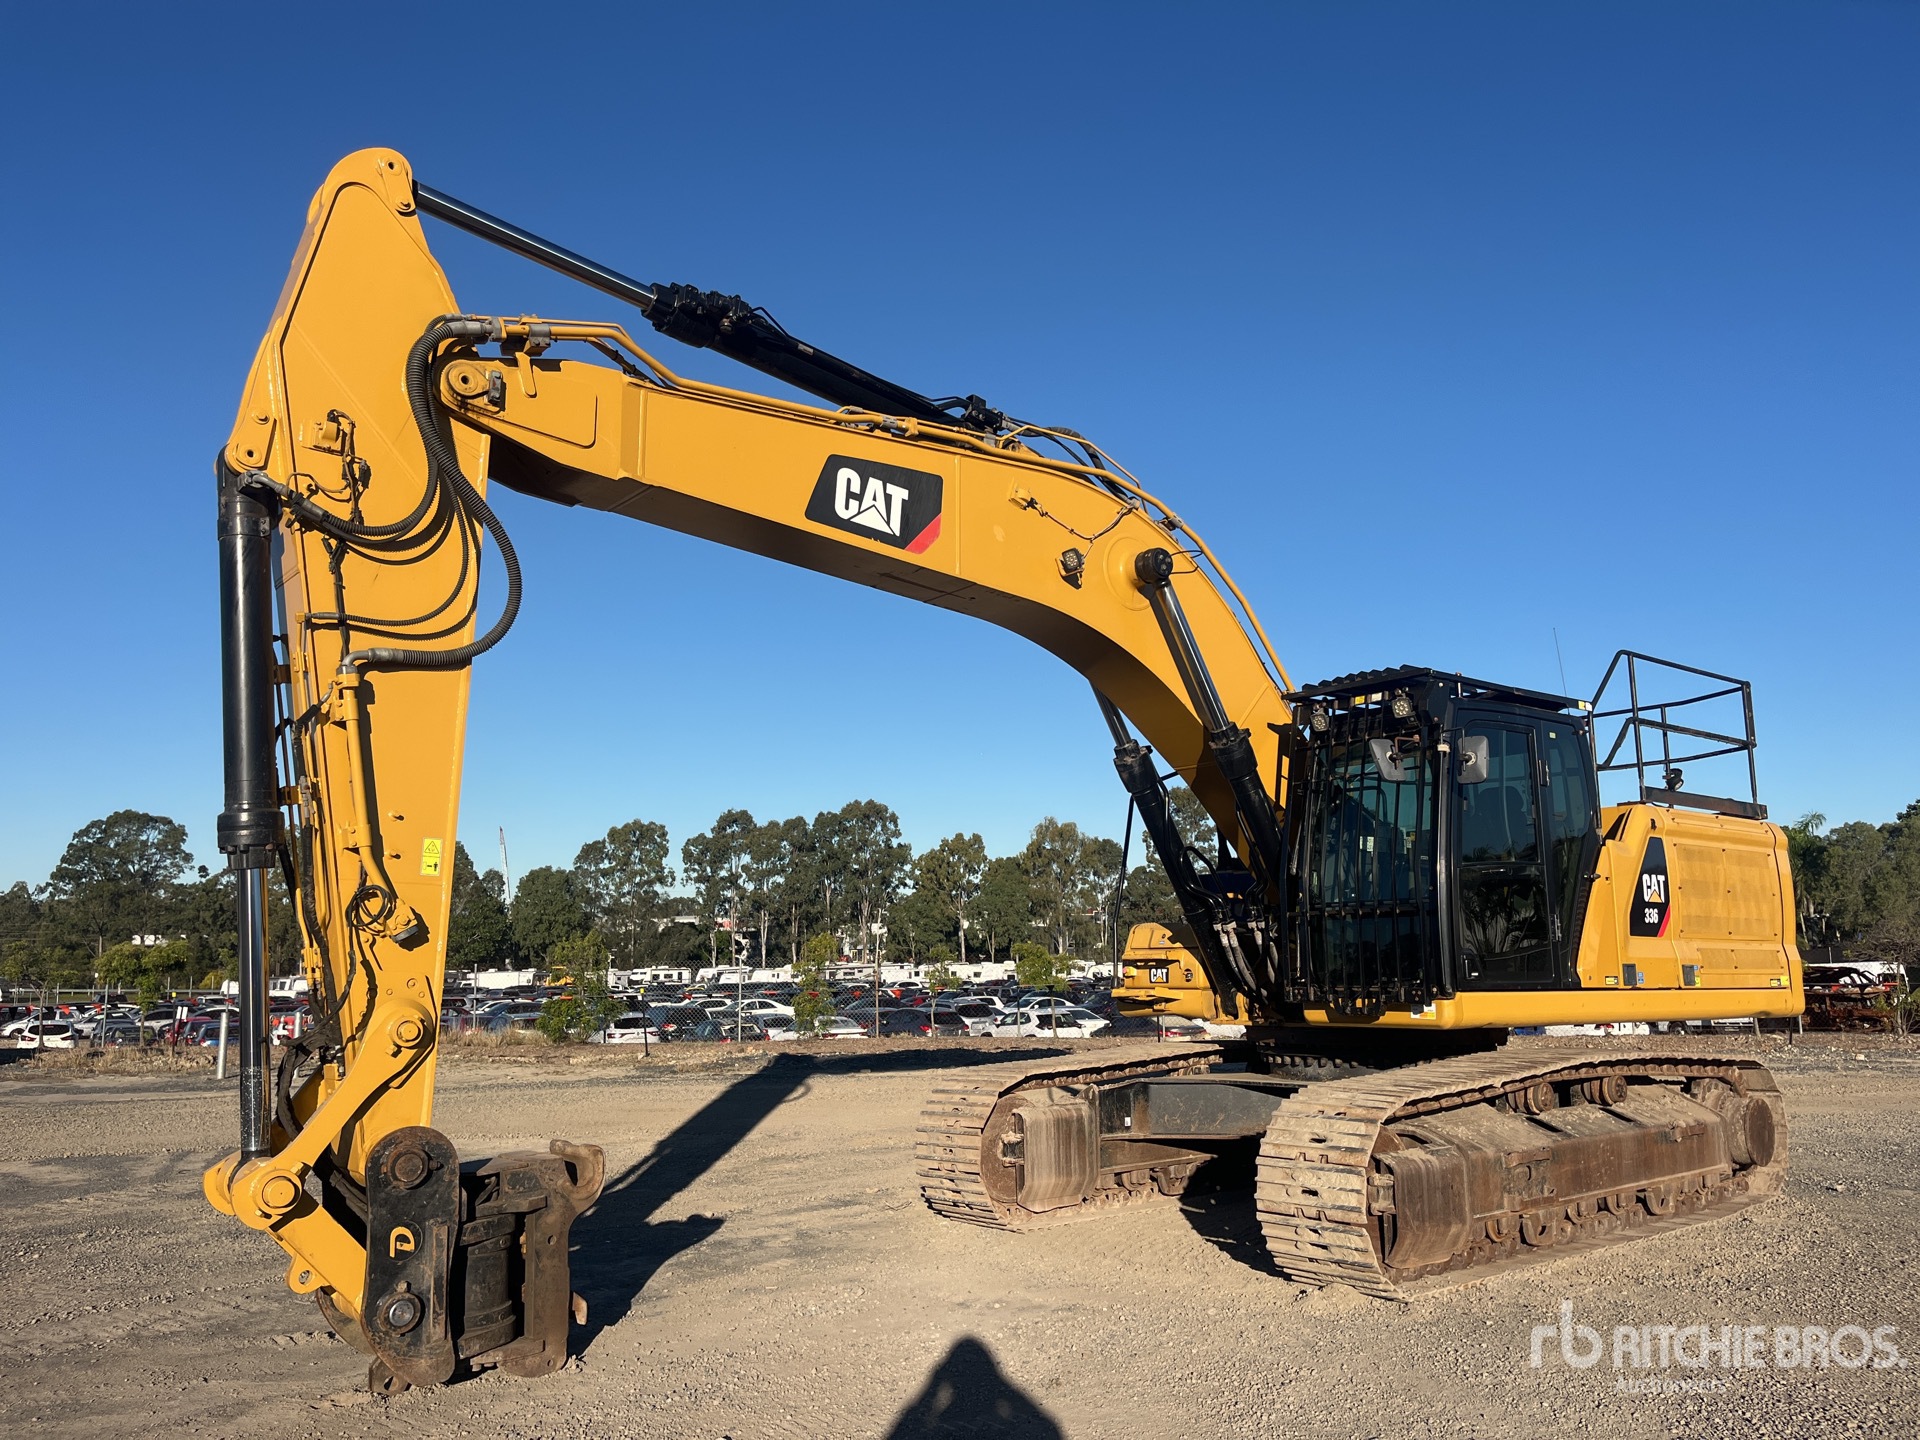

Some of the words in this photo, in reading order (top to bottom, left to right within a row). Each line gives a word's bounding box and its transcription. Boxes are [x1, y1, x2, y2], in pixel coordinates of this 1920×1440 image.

[834, 467, 909, 537] CAT
[1642, 873, 1665, 903] CAT
[1644, 908, 1659, 924] 336
[1150, 968, 1168, 982] CAT
